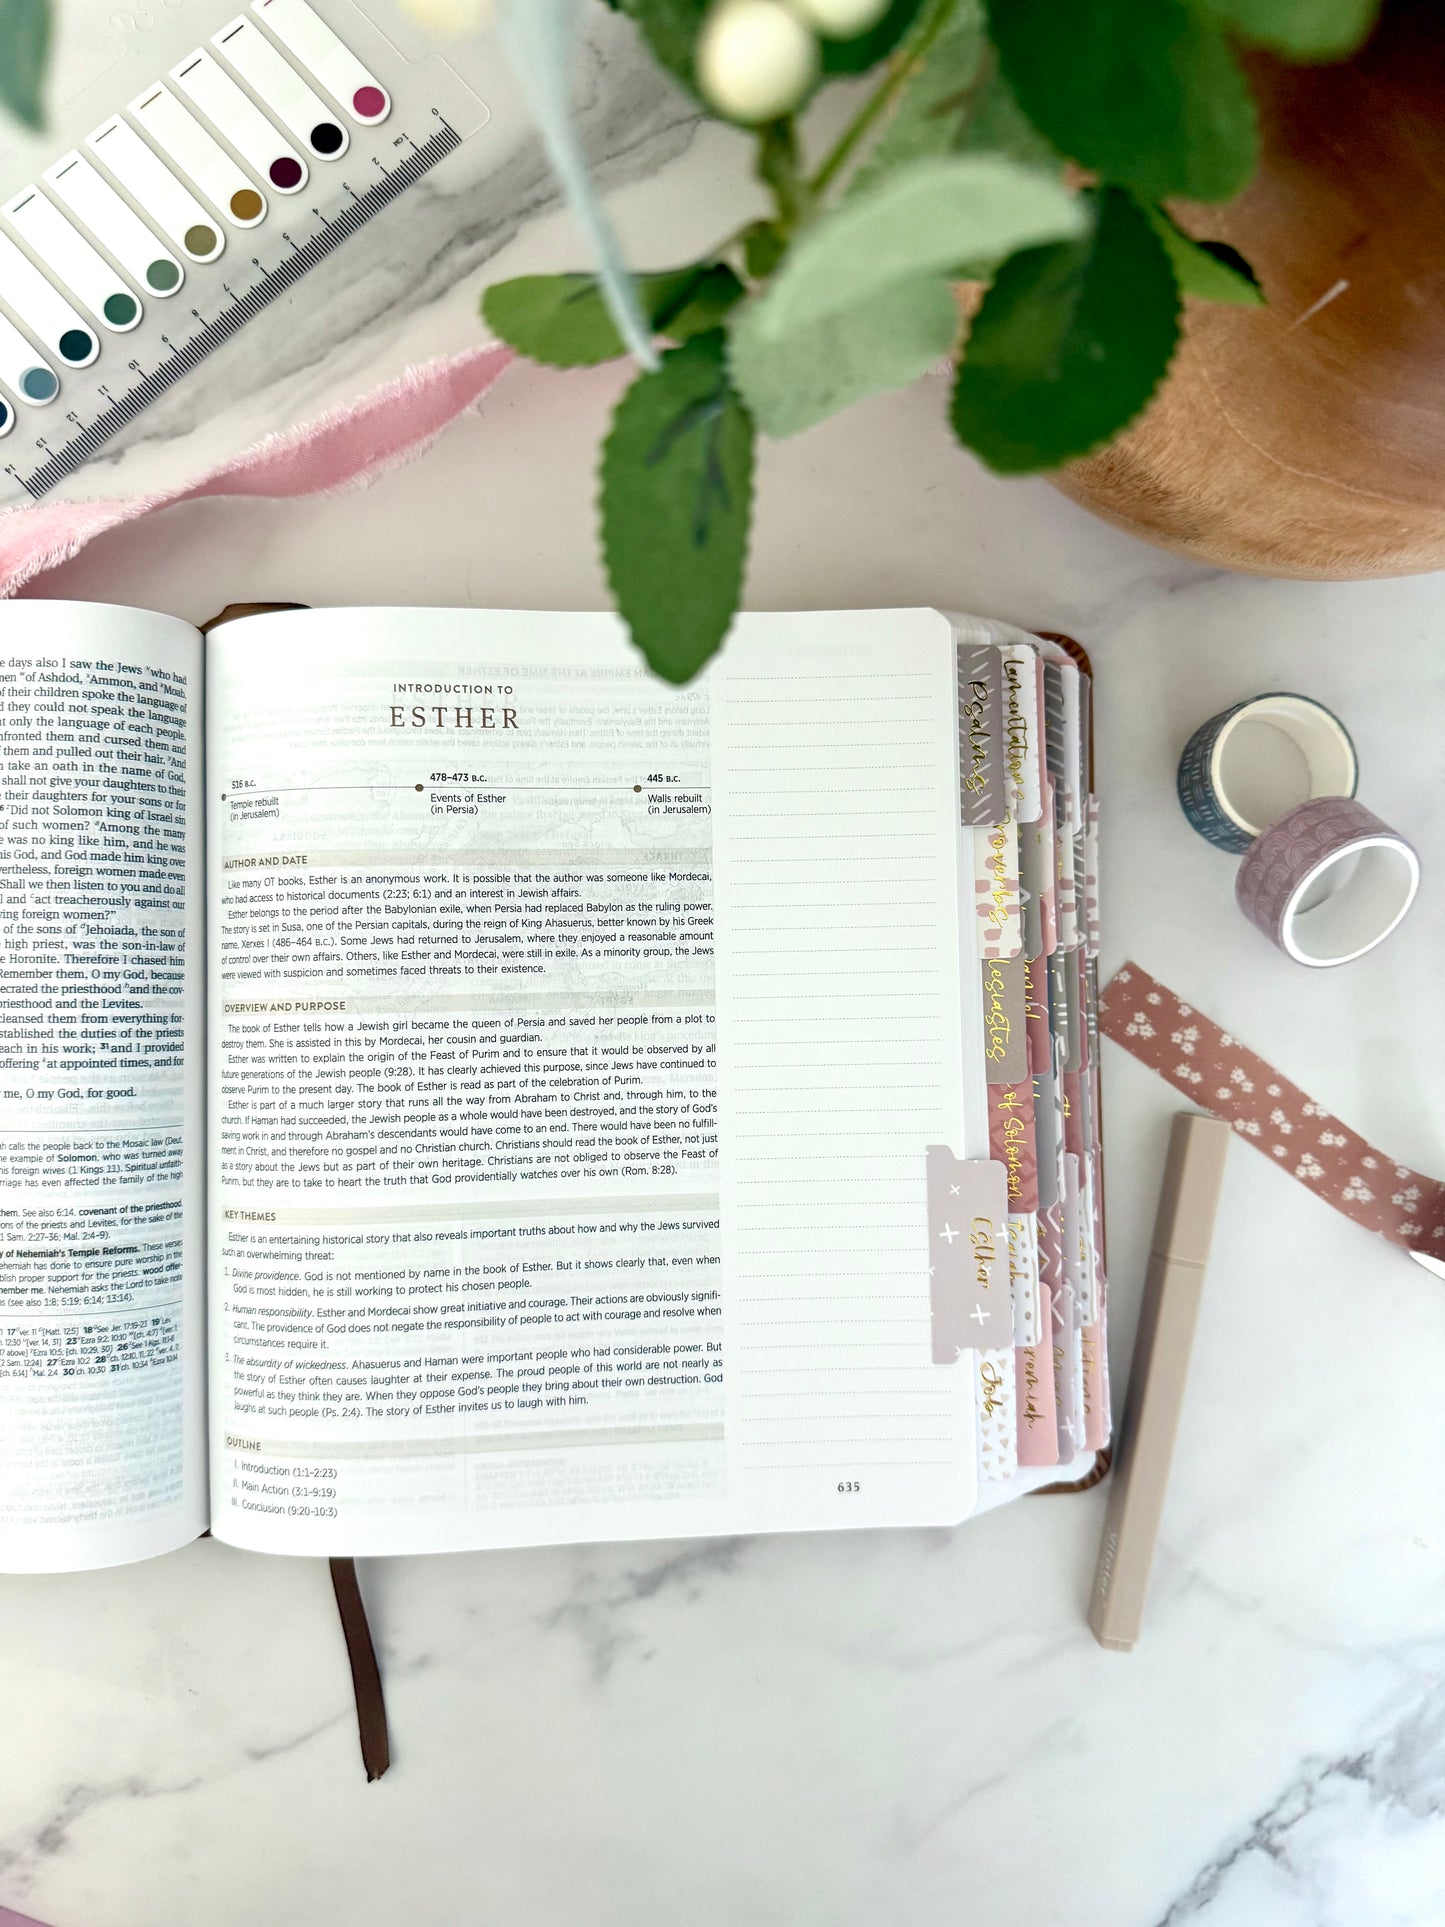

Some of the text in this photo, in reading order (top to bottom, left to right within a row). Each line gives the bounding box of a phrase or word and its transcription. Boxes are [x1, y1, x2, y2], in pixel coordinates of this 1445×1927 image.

[432, 108, 439, 116] 0
[372, 157, 380, 165] 2
[343, 182, 349, 190] 3
[283, 233, 290, 241] 5
[252, 258, 259, 266] 6
[223, 283, 230, 291] 7
[128, 360, 140, 370] 10
[98, 385, 109, 396] 11
[66, 411, 78, 422] 12
[36, 437, 47, 448] 13
[5, 464, 16, 475] 14
[393, 683, 513, 694] INTRODUCTION TO
[7, 686, 32, 697] their
[33, 686, 80, 698] children
[81, 689, 115, 701] spoke
[116, 690, 135, 703] the
[136, 693, 180, 711] language
[179, 703, 188, 713] of
[388, 706, 519, 729] ESTHER
[964, 681, 991, 797] Psalms
[471, 774, 487, 782] B.C.
[646, 773, 664, 782] 445
[231, 779, 256, 789] 516 B.C.
[229, 796, 280, 810] Temple rebuilt
[430, 792, 506, 803] Events of Esther
[646, 793, 702, 803] Walls rebuilt
[430, 804, 478, 815] (in Persia)
[647, 804, 712, 815] (in Jerusalem)
[229, 810, 280, 822] (in Jerusalem)
[223, 854, 308, 869] AUTHOR AND DATE
[227, 871, 712, 889] Like many OT books, Esther is an anonymous work. It is possible that the author was someone like Mordecai,
[221, 887, 582, 904] who had access to historical documents (2:23; 6:1) and an interest in Jewish affairs.
[21, 908, 60, 922] foreign
[62, 909, 116, 920] women?”
[224, 1000, 346, 1013] OVERVIEW AND PURPOSE
[221, 1032, 543, 1050] destroy them. She is assisted in this by Mordecai, her cousin and guardian.
[3, 1086, 137, 1100] me, O my God, for good.
[998, 1092, 1027, 1202] of Solomon
[224, 1209, 276, 1221] KEY THEMES
[968, 1217, 996, 1289] Esther
[980, 1361, 1003, 1418] Job
[234, 1394, 589, 1418] laughs at such people (Ps. 2:4). The story of Esther invites us to laugh with him.
[226, 1436, 262, 1451] OUTLINE
[241, 1460, 290, 1476] Introduction
[241, 1479, 260, 1492] Main
[260, 1483, 289, 1495] Action
[837, 1481, 860, 1493] 635
[241, 1498, 286, 1514] Conclusion
